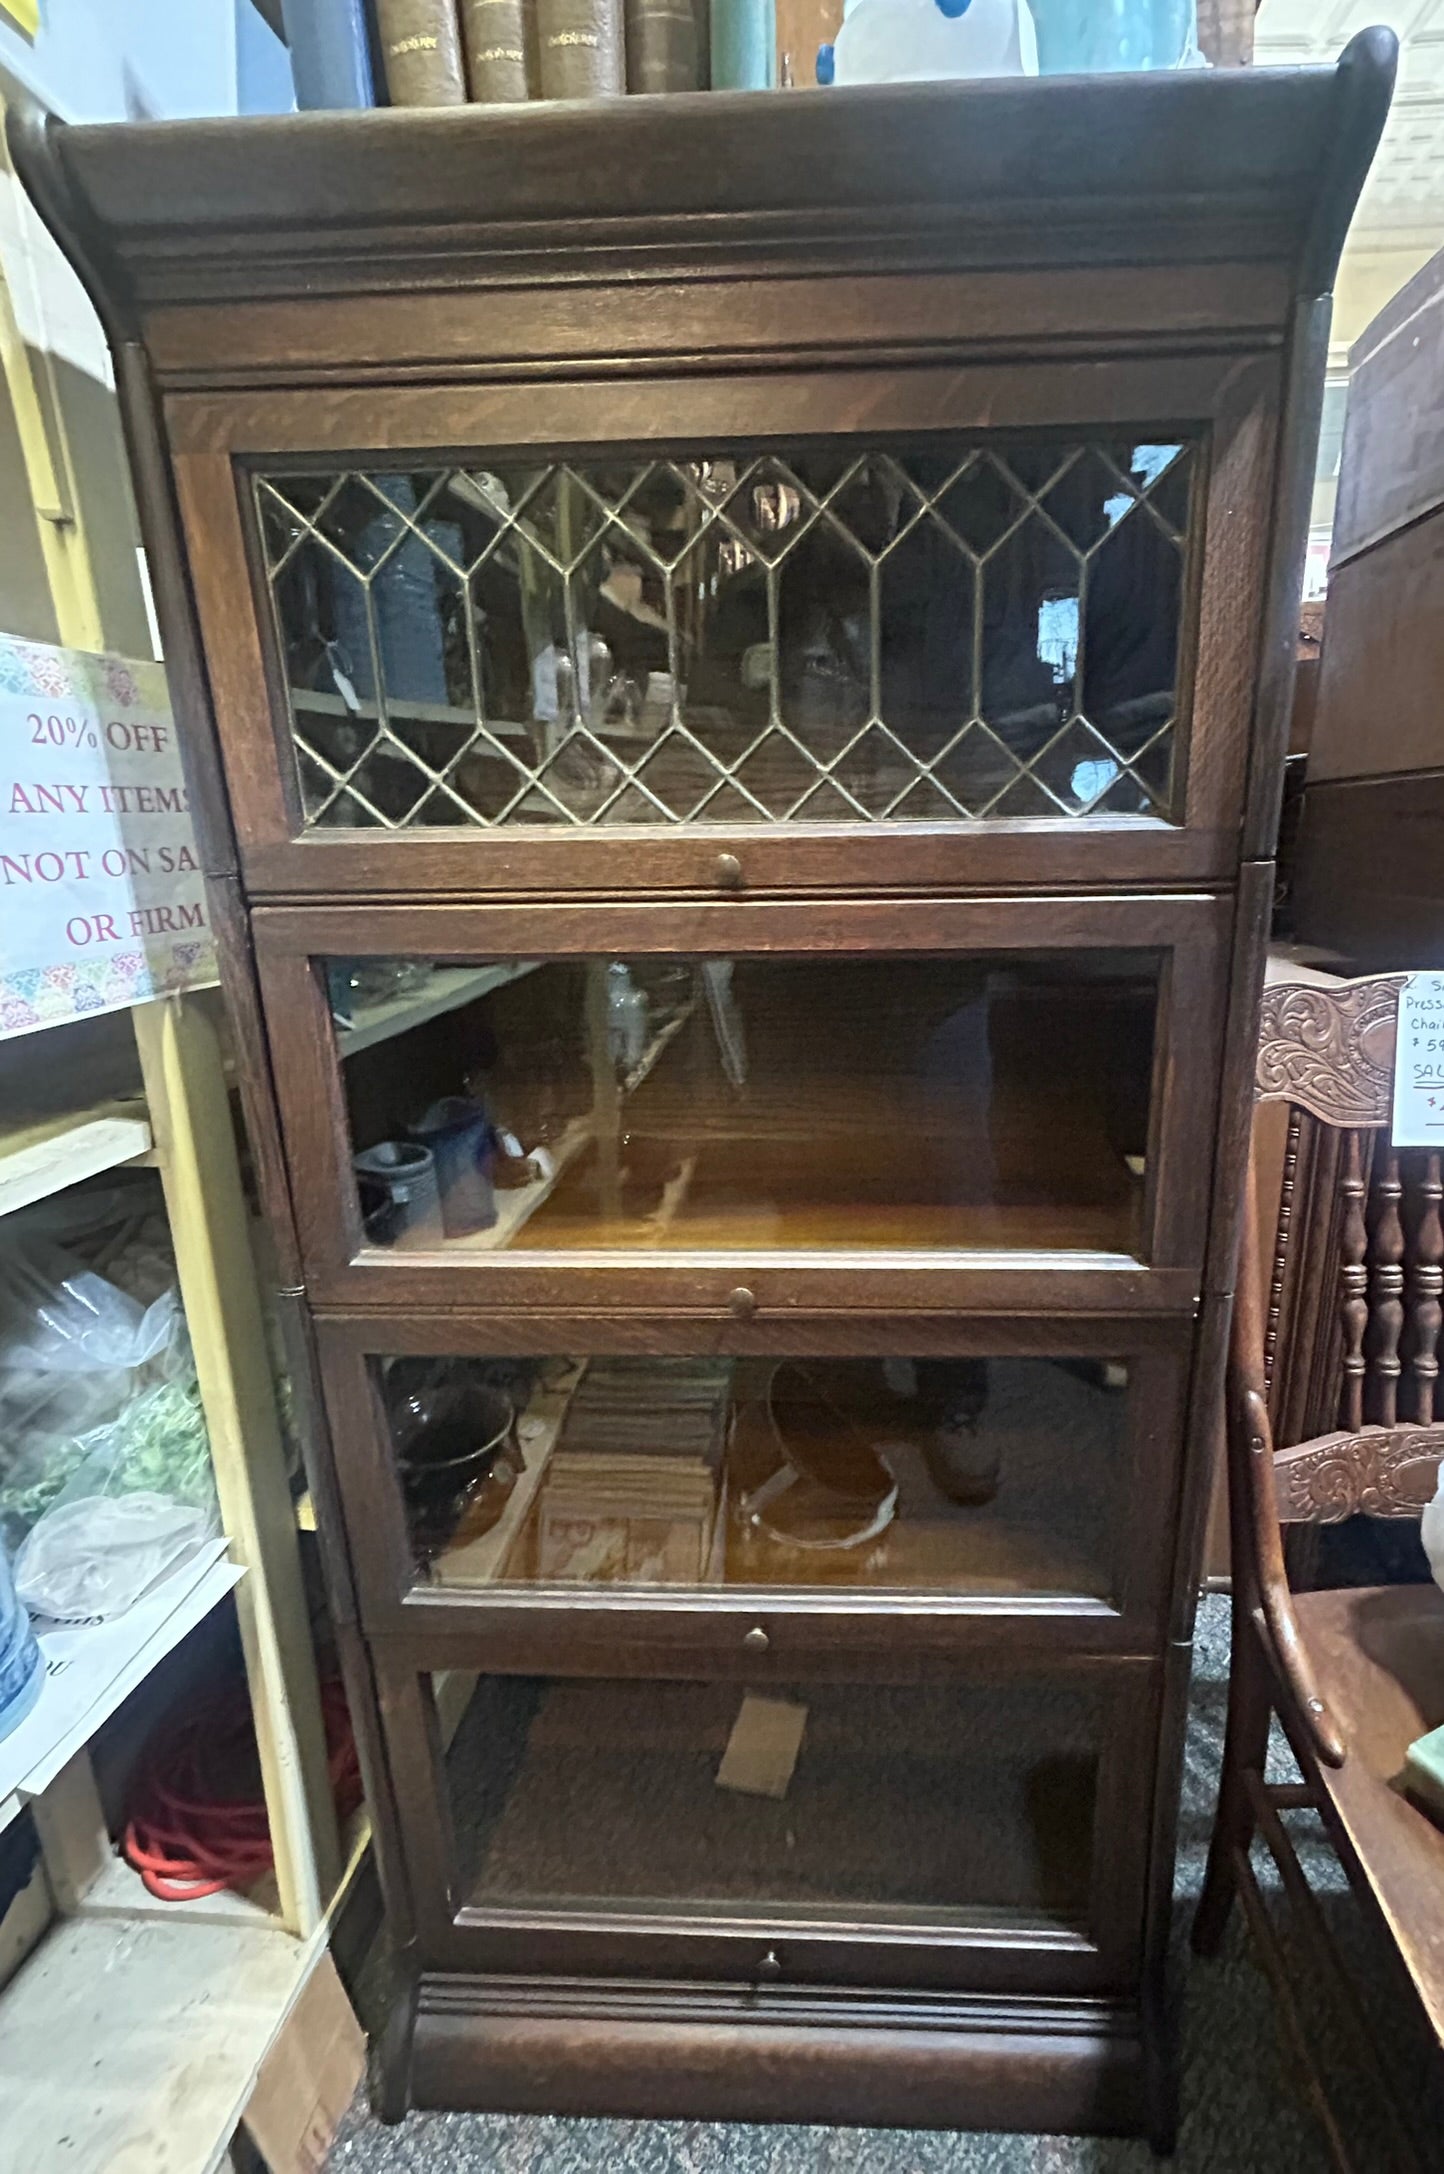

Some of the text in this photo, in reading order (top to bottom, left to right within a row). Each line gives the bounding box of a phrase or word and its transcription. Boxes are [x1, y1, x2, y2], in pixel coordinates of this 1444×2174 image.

[26, 713, 168, 753] 20% OFF
[8, 782, 90, 814] ANY
[1, 851, 91, 885] NOT
[101, 848, 151, 878] ON
[65, 902, 206, 946] OR FIRM
